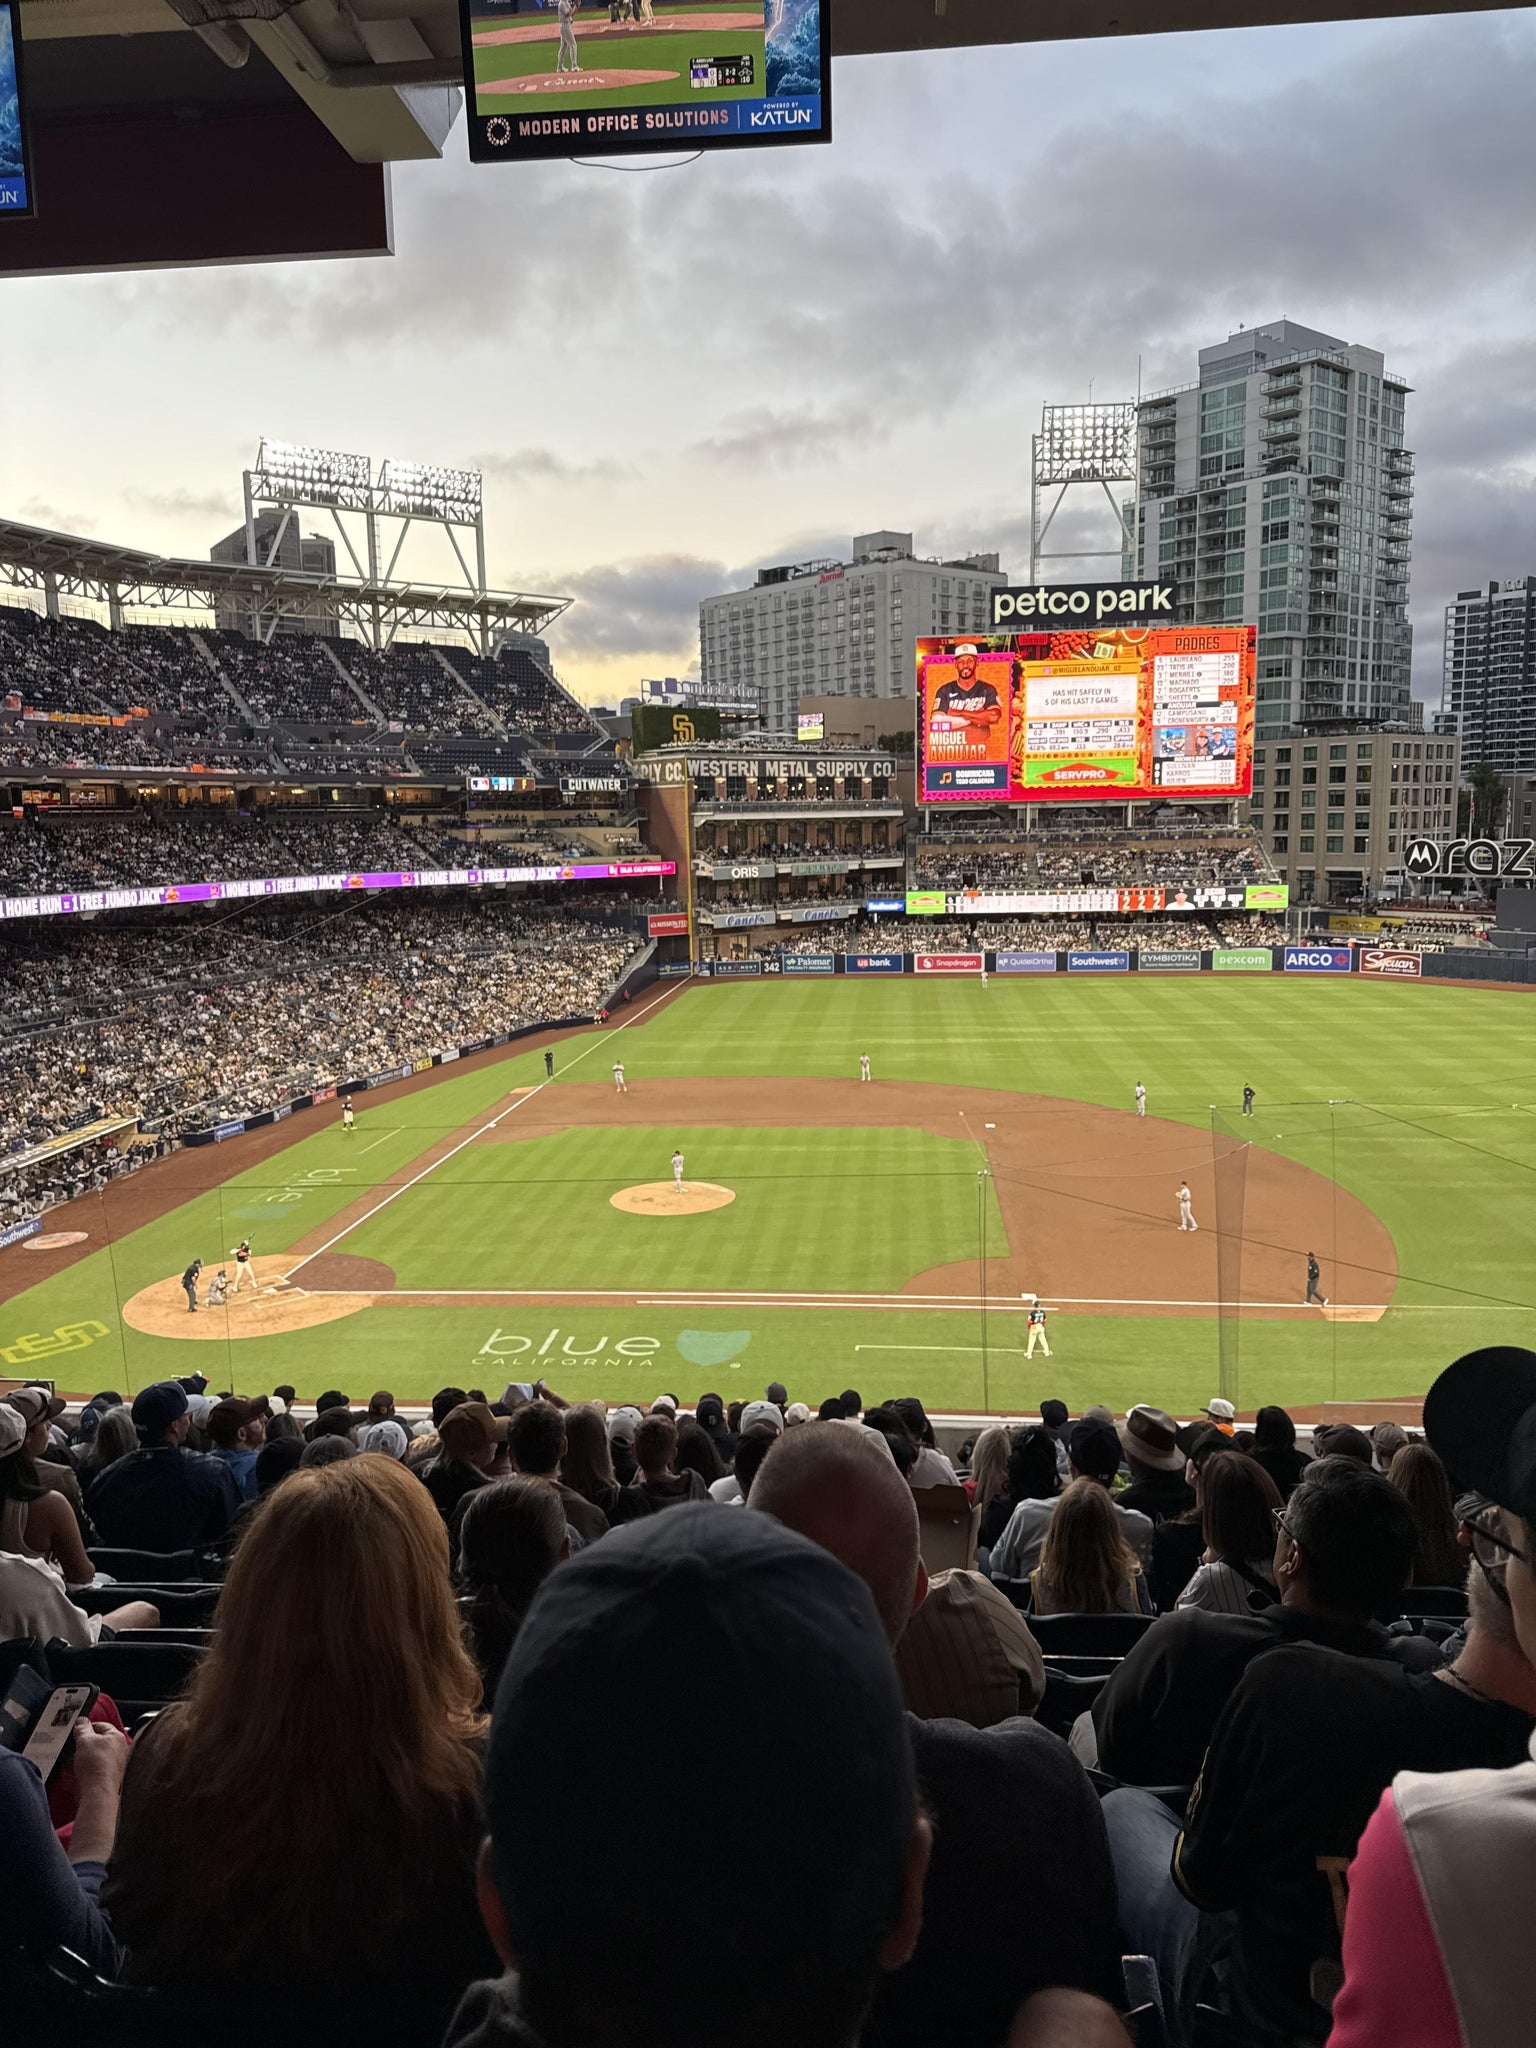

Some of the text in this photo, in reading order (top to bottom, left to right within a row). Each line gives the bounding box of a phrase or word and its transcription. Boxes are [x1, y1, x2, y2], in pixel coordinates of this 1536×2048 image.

[519, 109, 729, 136] MODERN OFFICE SOLUTIONS
[751, 109, 811, 126] KATUN
[994, 584, 1172, 624] petco park
[1176, 636, 1220, 650] PADRES
[1080, 688, 1103, 696] SAFELY
[930, 731, 967, 745] MIGUEL
[929, 745, 986, 761] ANDUJAR
[688, 760, 895, 777] WESTERN METAL SUPPLY CO.
[1054, 770, 1106, 780] SERVPRO
[568, 778, 621, 791] CUTWATER
[414, 874, 420, 884] 1
[421, 873, 448, 884] HOME
[450, 872, 468, 884] RUN
[477, 872, 482, 882] 1
[484, 871, 504, 882] FREE
[506, 869, 535, 881] JUMBO
[731, 866, 759, 878] ORIS
[220, 884, 226, 897] 1
[226, 883, 249, 897] HOME
[250, 882, 265, 895] RUN
[272, 881, 276, 893] 1
[278, 880, 294, 893] FREE
[295, 878, 317, 891] JUMBO
[6, 898, 39, 916] HOME
[40, 896, 62, 914] RUN
[72, 896, 78, 911] 1
[80, 895, 104, 910] FREE
[105, 892, 137, 910] JUMBO
[1123, 897, 1130, 910] 2
[1138, 896, 1146, 909] 2
[1152, 896, 1161, 909] 2
[726, 912, 765, 926] Canel's
[804, 908, 839, 920] Canel's
[699, 926, 713, 936] 336
[797, 958, 831, 966] Palomar
[857, 958, 891, 967] us bank
[936, 959, 976, 968] Snapdragon
[1010, 958, 1054, 967] QuidelOrtho
[1072, 956, 1118, 966] Southwest
[1141, 954, 1198, 962] CYMBIOTIKA
[1287, 953, 1332, 966] ARCO
[1365, 952, 1415, 972] Sycuan
[764, 962, 780, 972] 342
[478, 1328, 661, 1356] blue
[472, 1358, 653, 1367] CALIFORNIA
